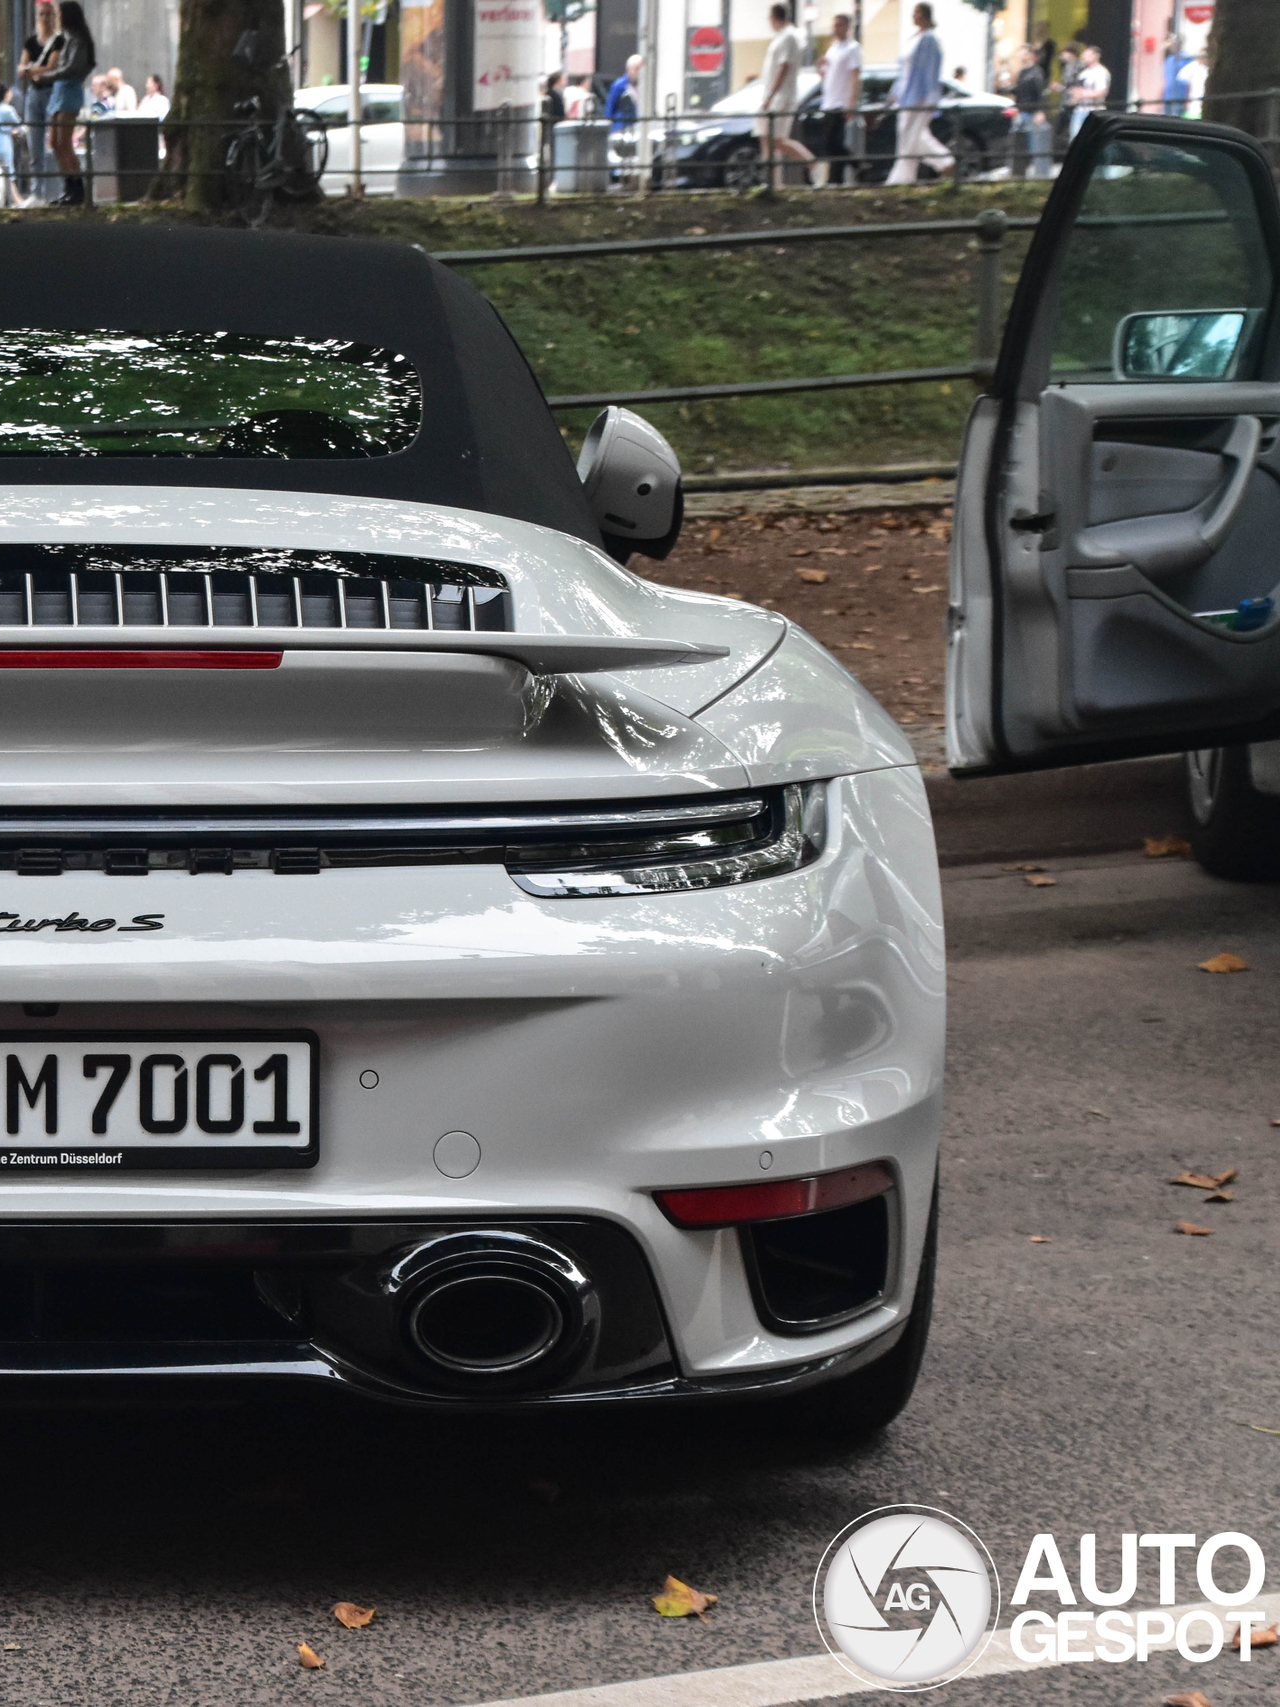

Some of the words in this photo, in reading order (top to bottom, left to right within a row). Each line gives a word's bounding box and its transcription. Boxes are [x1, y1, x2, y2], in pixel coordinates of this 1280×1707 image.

[118, 914, 165, 931] S
[6, 1054, 57, 1135] M
[83, 1054, 300, 1135] 7001
[10, 1153, 58, 1165] Zentrum
[61, 1152, 123, 1165] Düsseldorf
